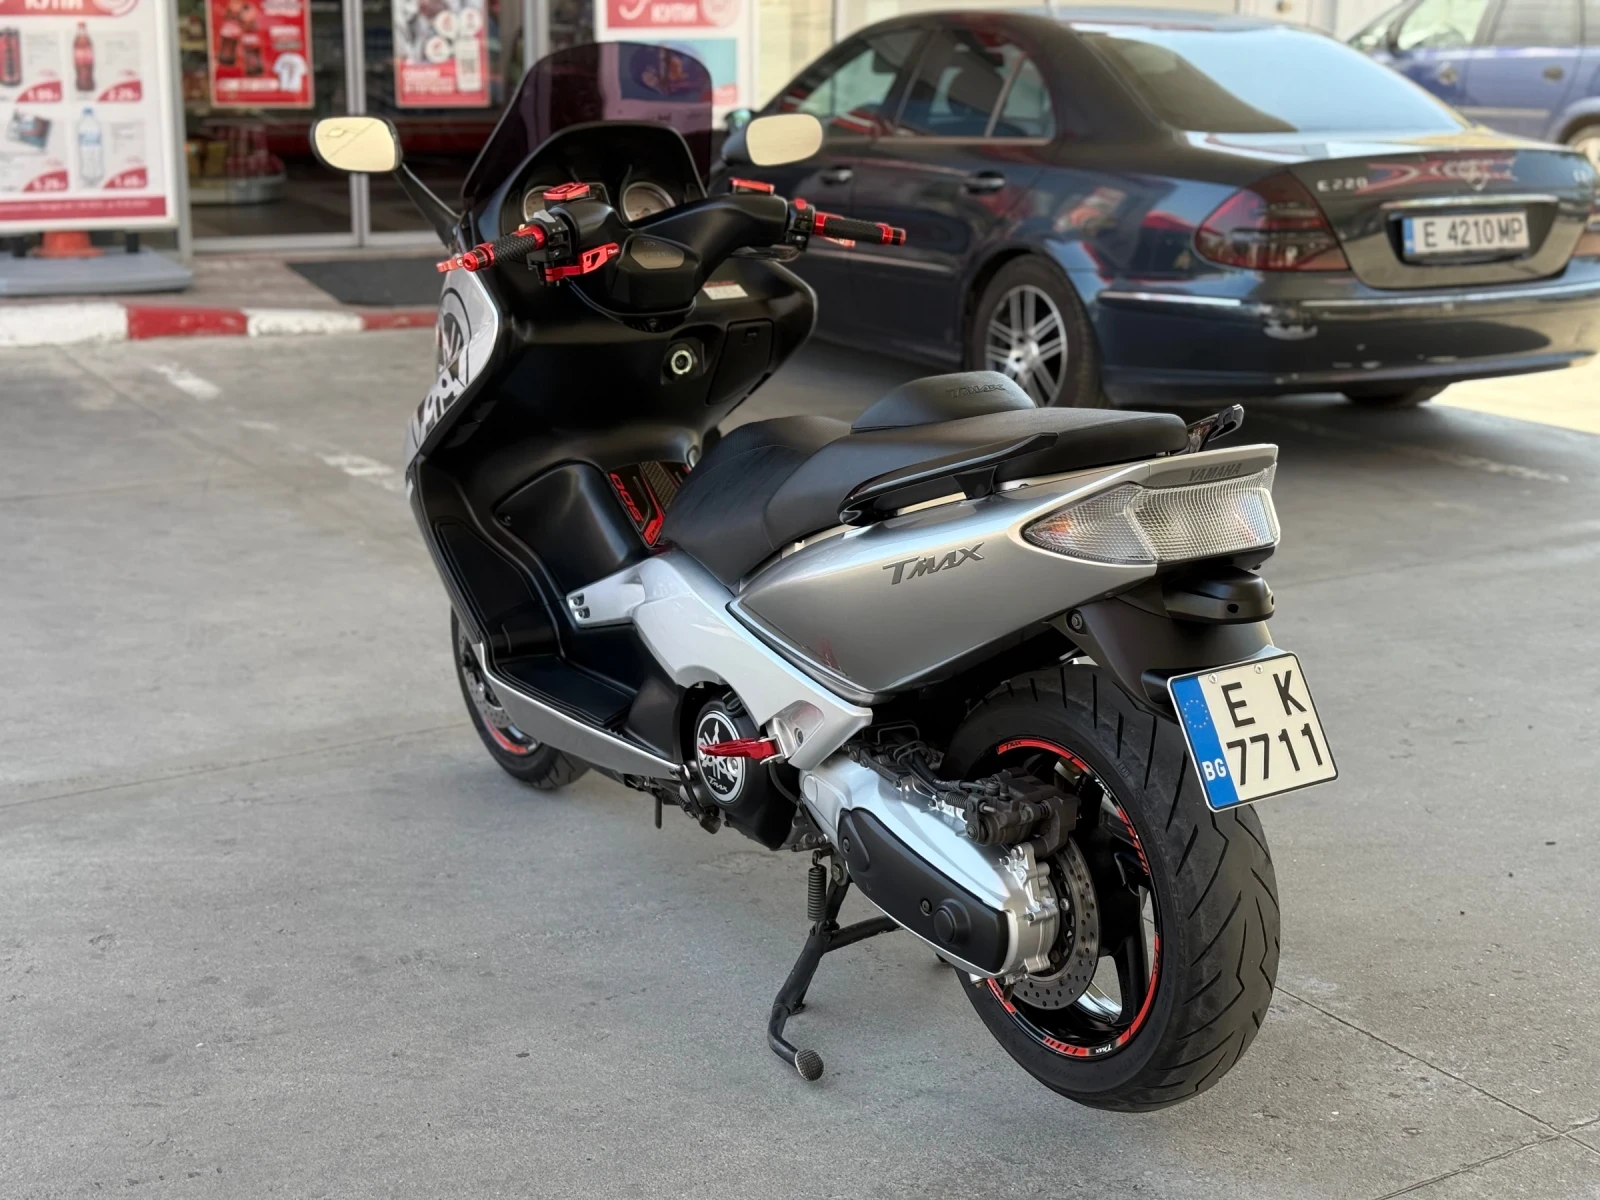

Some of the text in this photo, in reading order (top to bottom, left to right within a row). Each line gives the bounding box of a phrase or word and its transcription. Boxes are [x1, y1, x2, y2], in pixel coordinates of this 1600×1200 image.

[1423, 217, 1523, 248] E 4210 MP
[1188, 462, 1243, 482] YAMAHA
[882, 541, 985, 586] TMAX
[1221, 669, 1308, 728] E K
[1201, 722, 1323, 787] BG 7711
